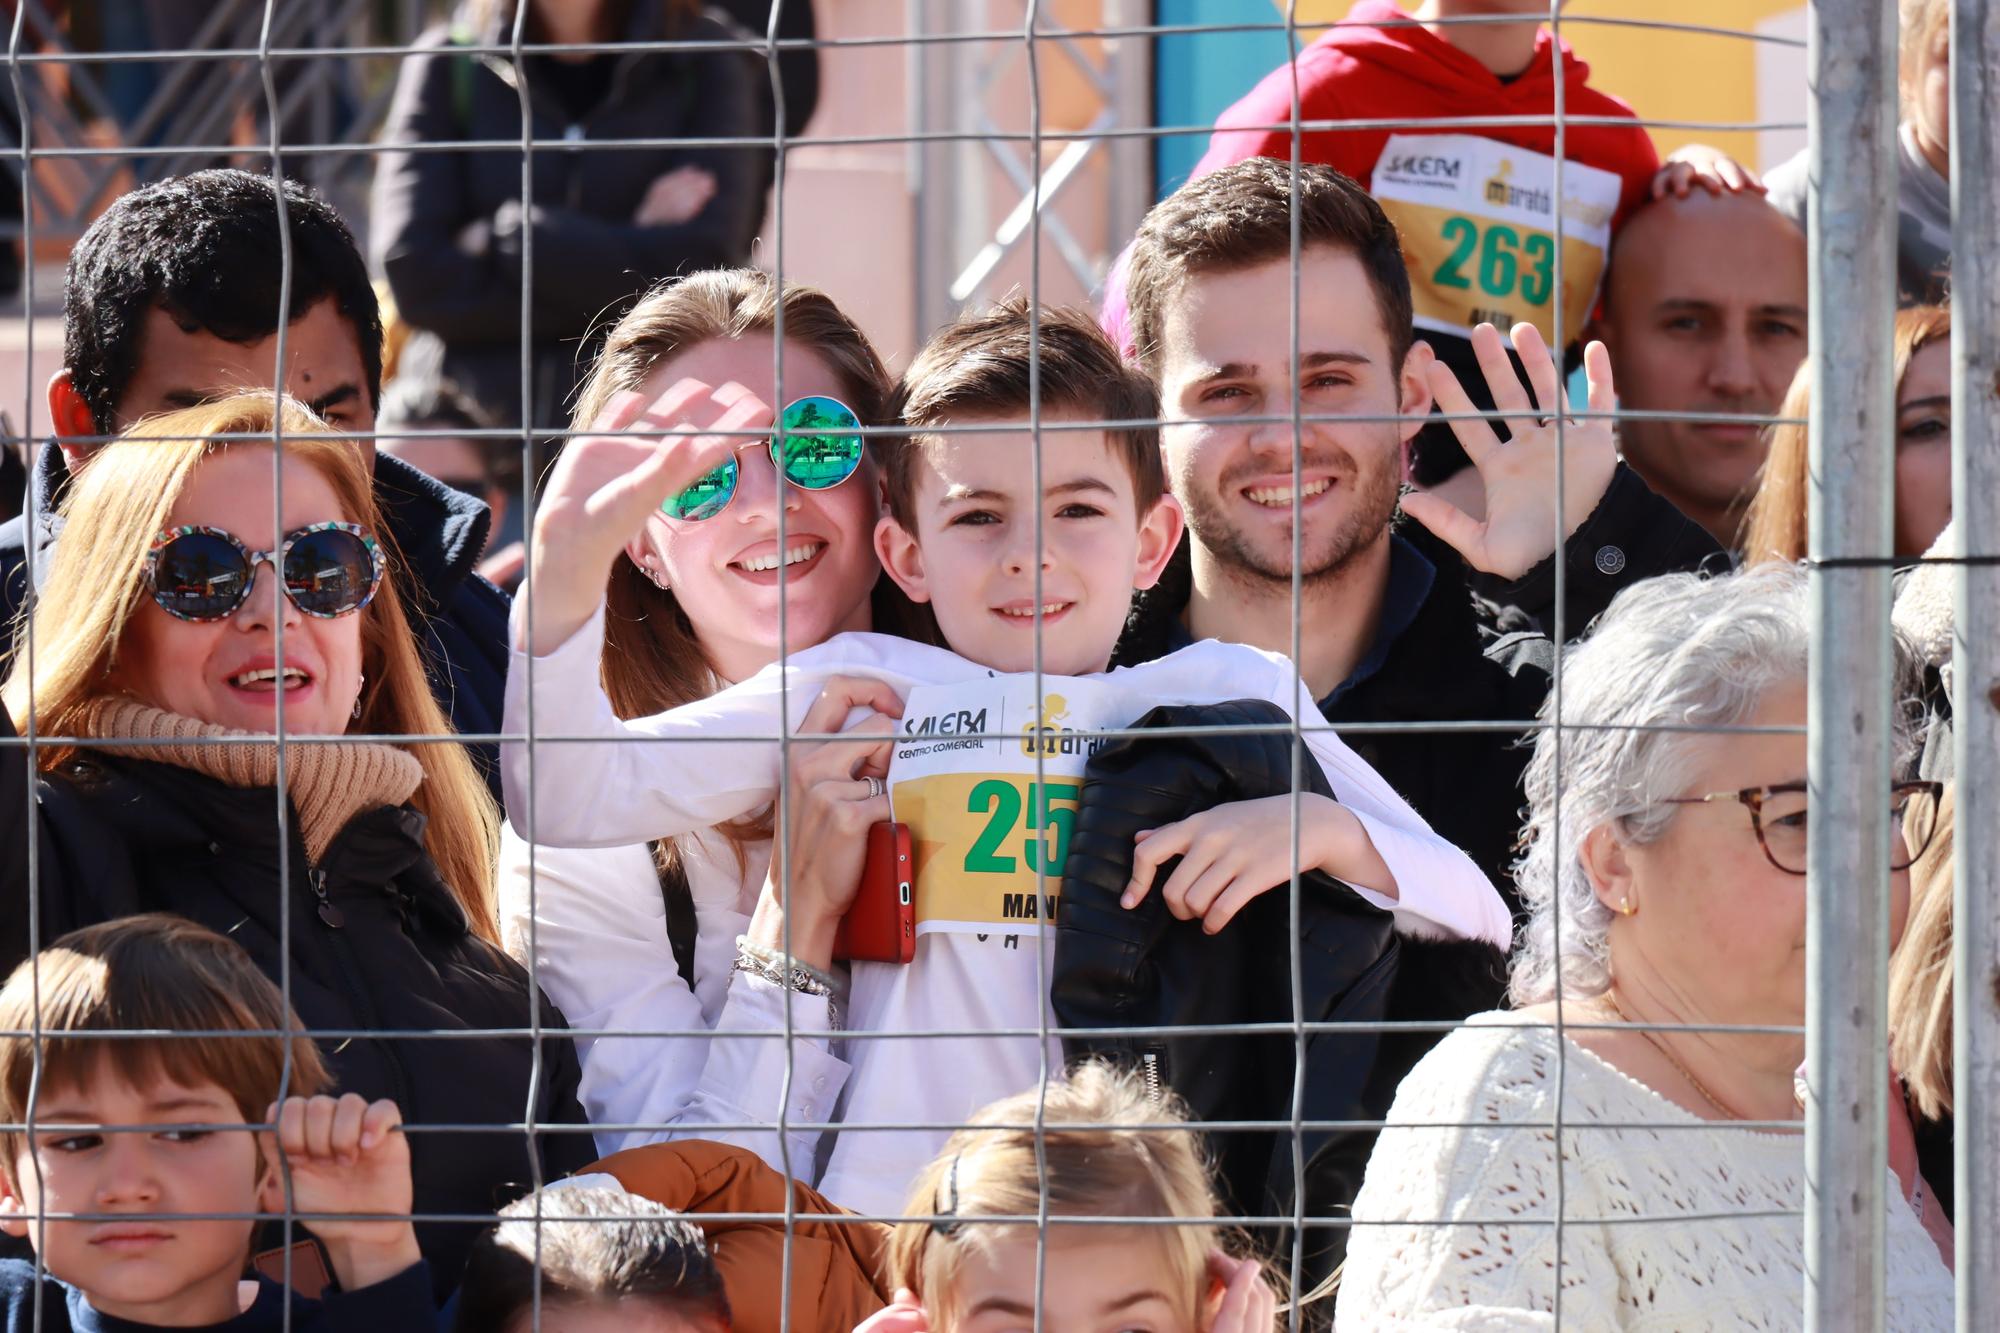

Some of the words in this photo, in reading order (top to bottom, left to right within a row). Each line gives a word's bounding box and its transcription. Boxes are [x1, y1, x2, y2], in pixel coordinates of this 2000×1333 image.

[1432, 216, 1555, 307] 263
[900, 708, 987, 743] SALERA
[898, 746, 931, 759] CENTRO
[933, 739, 984, 753] COMERCIAL
[1003, 893, 1060, 920] MAN
